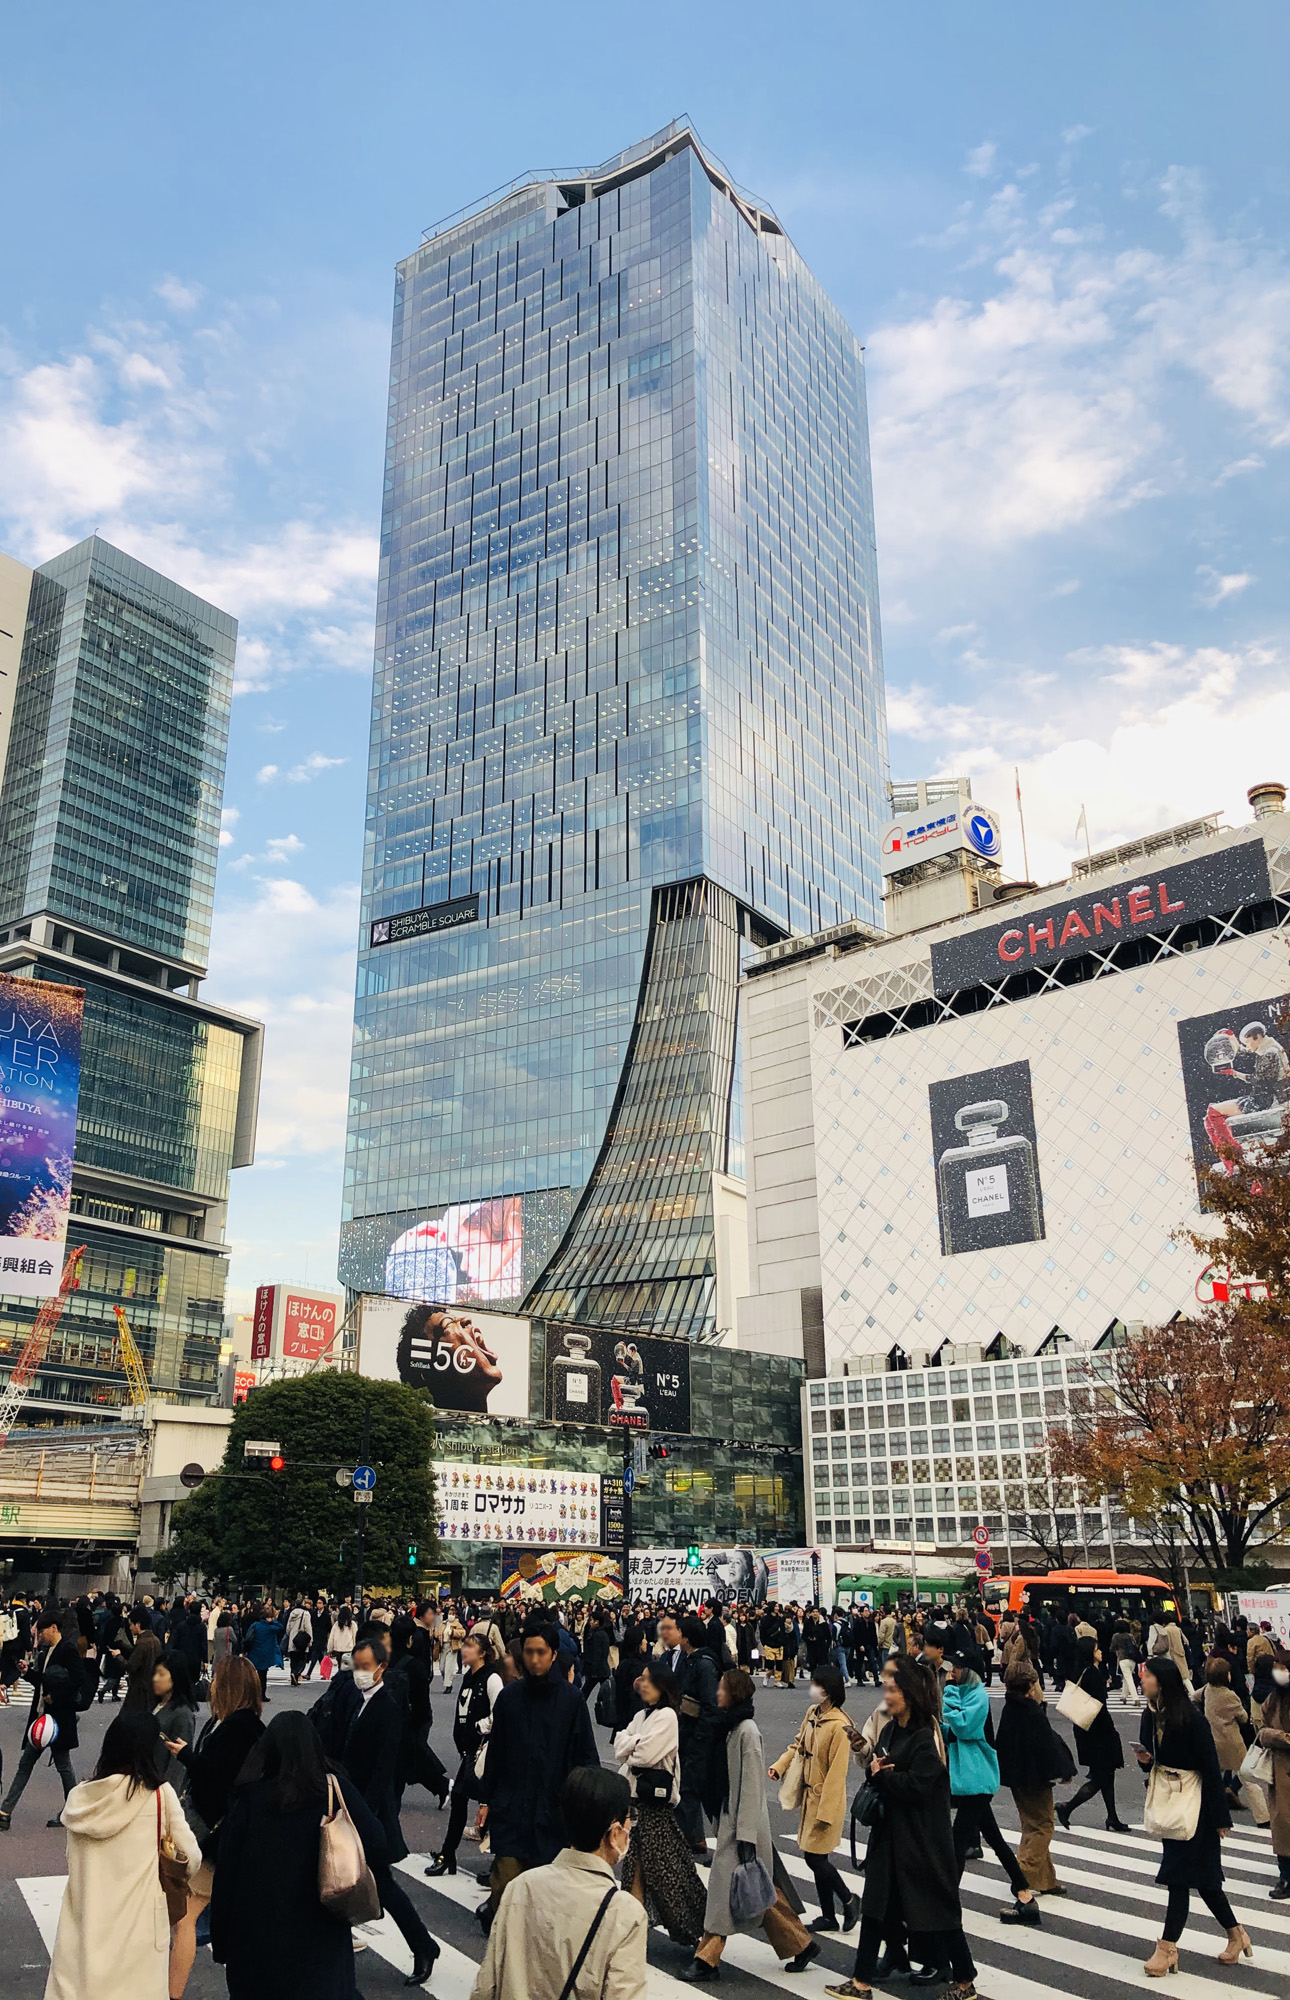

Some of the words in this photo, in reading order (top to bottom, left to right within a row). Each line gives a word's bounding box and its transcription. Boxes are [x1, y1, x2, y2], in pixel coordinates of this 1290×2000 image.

[903, 823, 959, 848] TOKYU
[390, 918, 437, 939] SCRAMBLE
[438, 908, 476, 926] SQUARE
[391, 911, 429, 929] SHIBUYA
[997, 882, 1186, 962] CHANEL
[976, 1174, 996, 1187] N°5
[971, 1192, 1005, 1205] CHANEL
[0, 1256, 54, 1276] 興組合
[288, 1300, 334, 1323] ほけんの
[256, 1288, 269, 1356] ほけんの窓口
[297, 1322, 321, 1341] 窓口
[410, 1360, 431, 1370] SoftBank
[433, 1341, 477, 1374] 5G
[234, 1376, 254, 1388] ECC
[656, 1372, 680, 1389] N°5
[659, 1388, 677, 1398] L'EAU
[610, 1414, 647, 1427] CHANEL
[446, 1441, 484, 1454] shibuya
[486, 1444, 518, 1456] station
[444, 1498, 469, 1512] 1周年
[474, 1493, 526, 1515] ロマサガ
[656, 1587, 711, 1608] GRAND
[715, 1587, 759, 1608] OPEN
